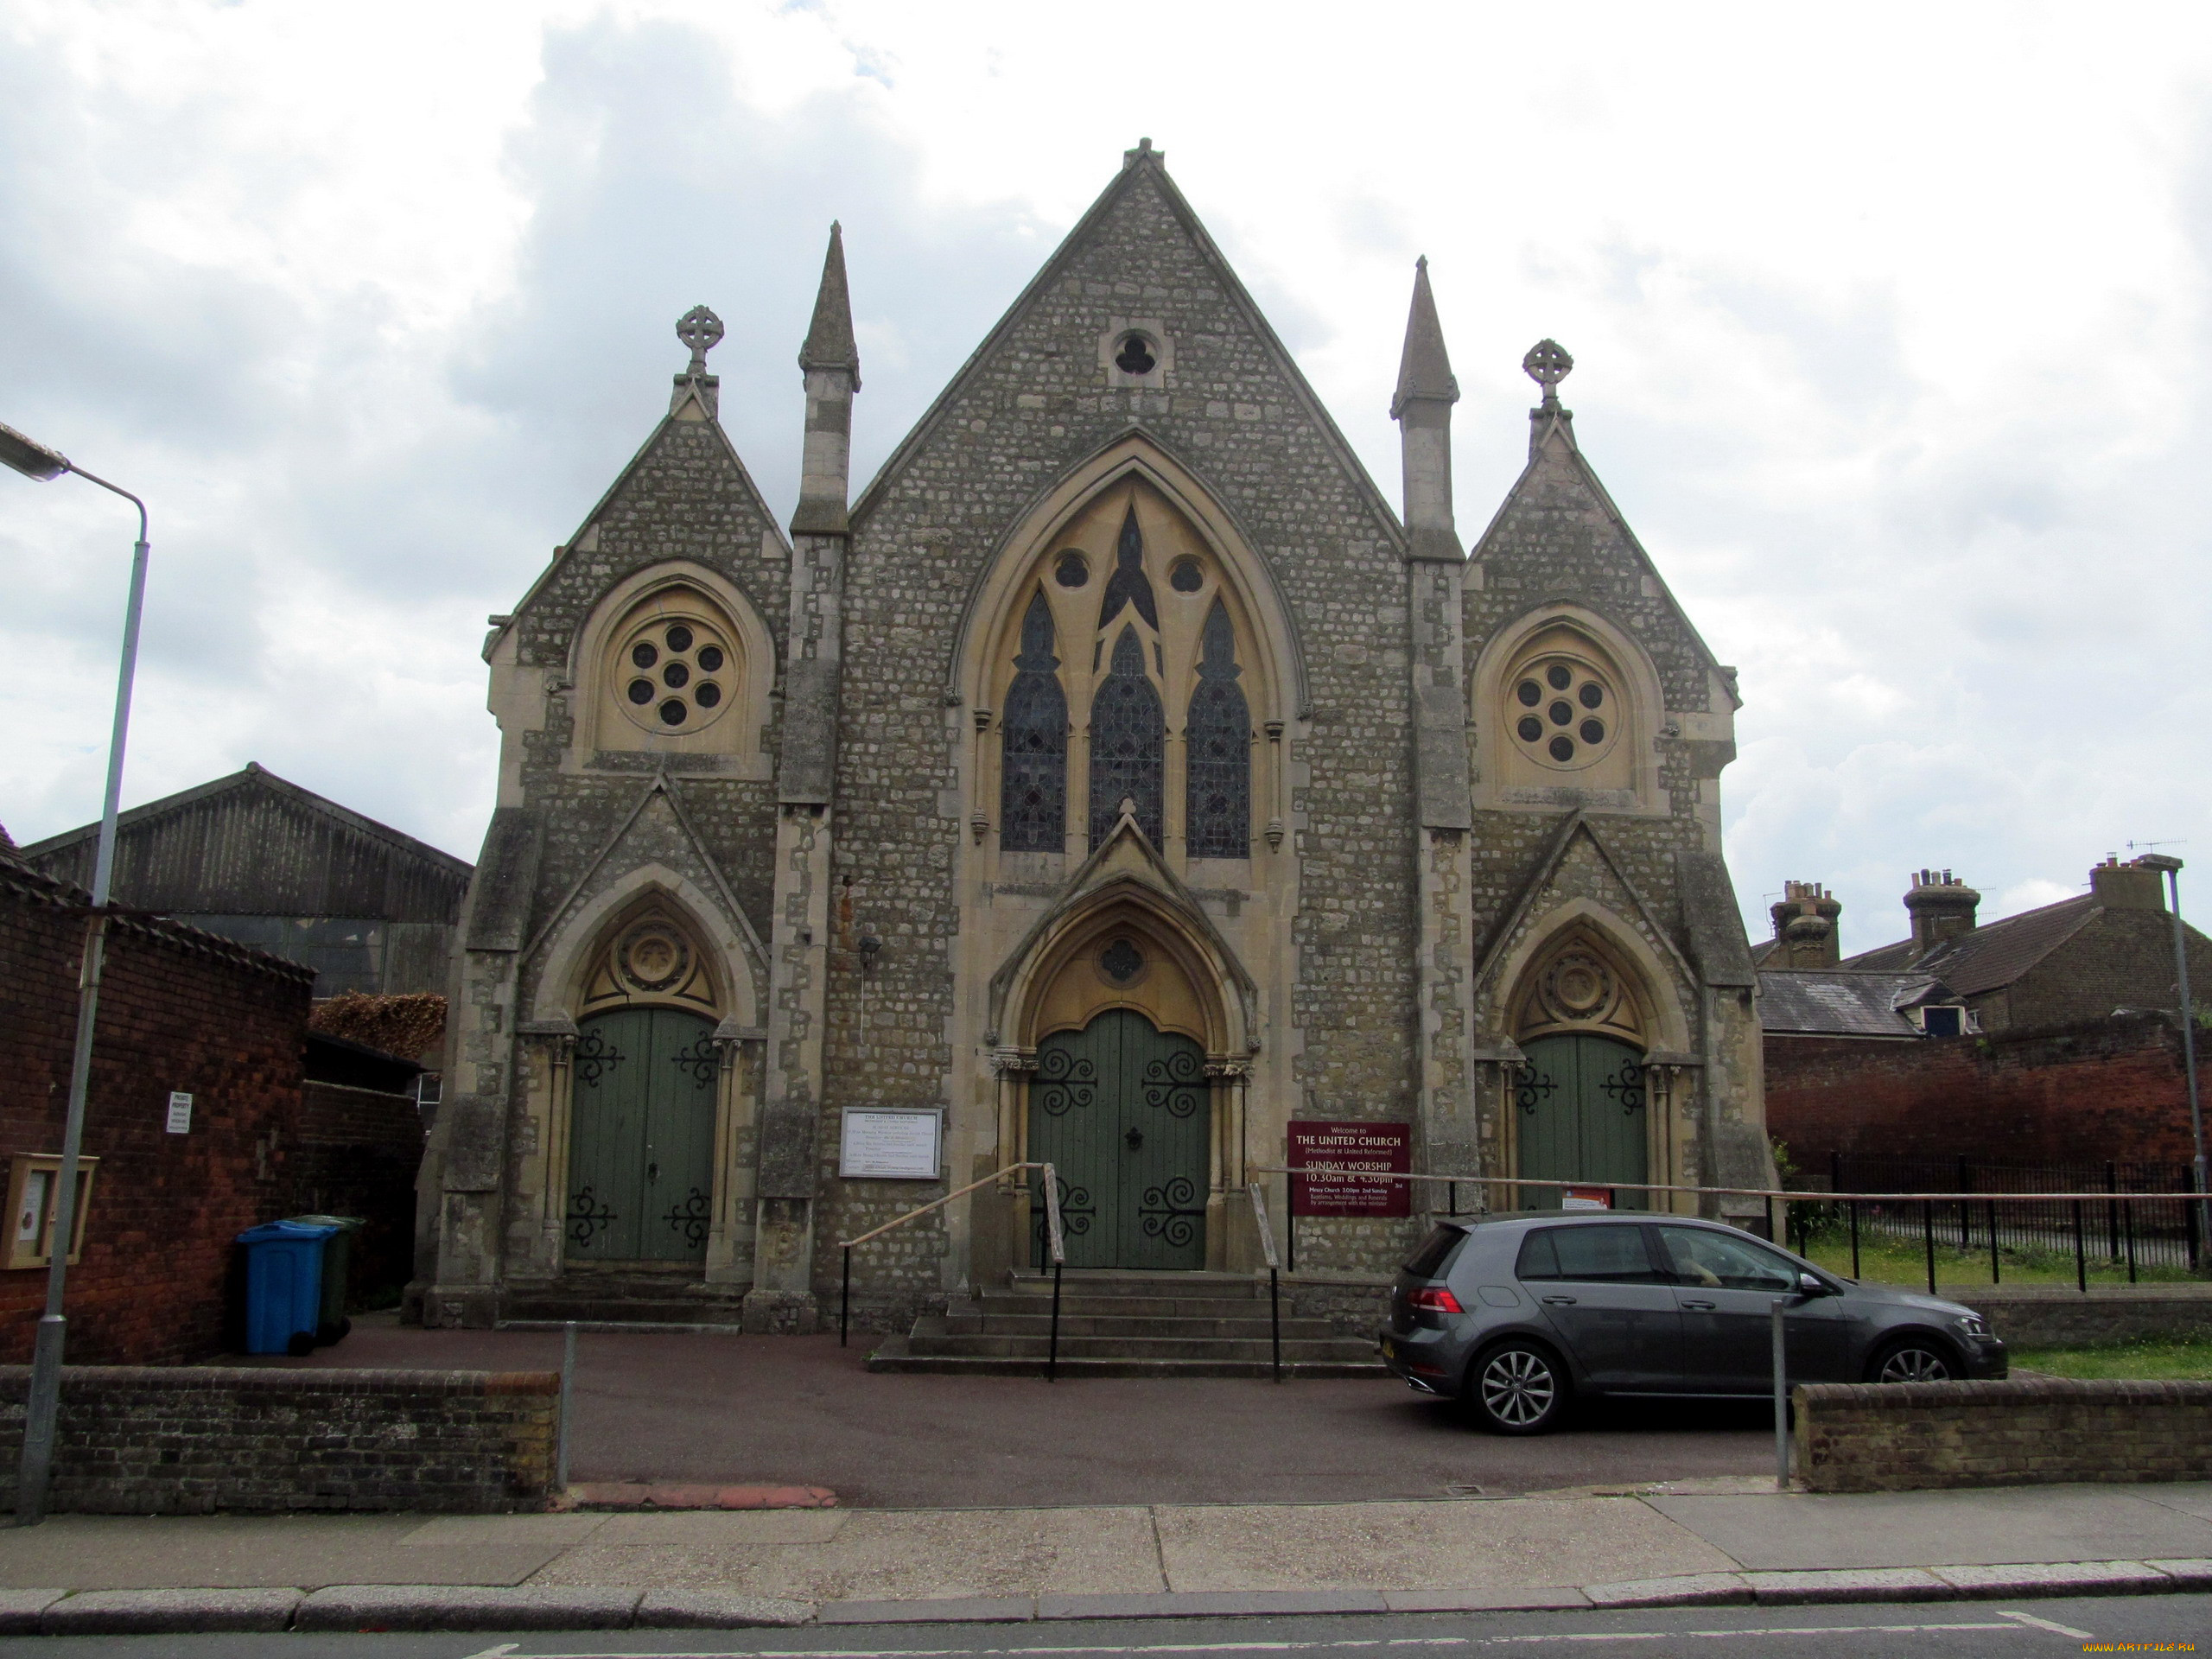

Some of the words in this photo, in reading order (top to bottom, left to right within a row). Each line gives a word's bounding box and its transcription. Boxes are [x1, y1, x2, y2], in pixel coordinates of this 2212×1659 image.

[1296, 1135, 1315, 1145] THE
[1319, 1136, 1355, 1145] UNITED
[1359, 1137, 1401, 1146] CHURCH
[1306, 1161, 1344, 1170] SUNDAY
[1348, 1162, 1392, 1171] WORSHIP
[1306, 1173, 1344, 1182] 10.30am
